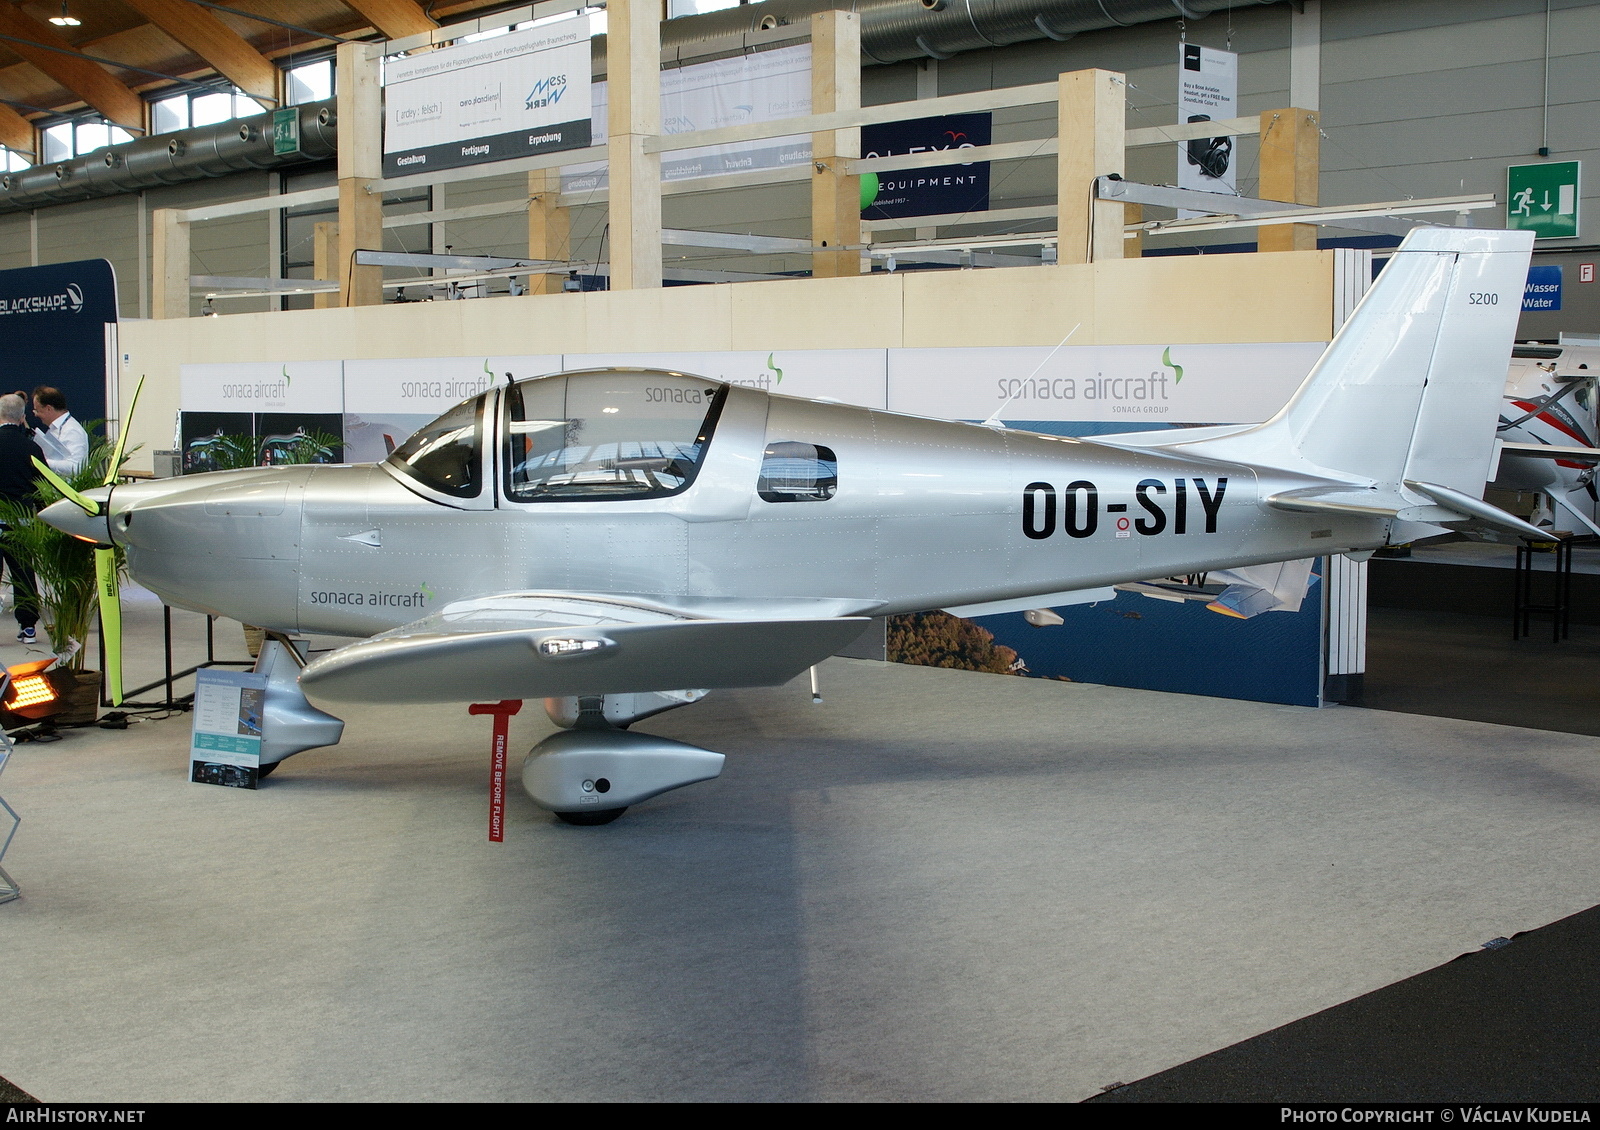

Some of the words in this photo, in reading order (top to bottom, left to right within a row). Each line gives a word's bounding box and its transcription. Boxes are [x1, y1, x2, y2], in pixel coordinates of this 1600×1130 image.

[529, 131, 562, 147] Erprobung
[461, 144, 490, 157] Fertigung
[397, 154, 426, 167] Gestaltung
[878, 175, 976, 191] EQUIPMENT
[1582, 267, 1590, 280] F
[1524, 283, 1559, 293] Wasser
[0, 294, 67, 315] BLACKSHAPE
[1469, 293, 1498, 305] S200
[1522, 298, 1553, 308] Water
[222, 384, 252, 398] sonaca
[254, 379, 286, 398] aircraft
[401, 381, 441, 398] sonaca
[444, 377, 487, 398] aircraft
[998, 378, 1076, 400] sonaca
[1084, 371, 1169, 400] aircraft
[645, 387, 700, 404] sonaca
[1112, 405, 1141, 414] SONACA
[1143, 405, 1169, 414] GROUP
[1022, 477, 1228, 540] OO-SIY
[311, 591, 364, 606] sonaca
[368, 590, 425, 608] aircraft
[496, 734, 504, 770] REMOVE
[494, 771, 502, 804] BEFORE
[492, 805, 501, 838] FLIGHT!
